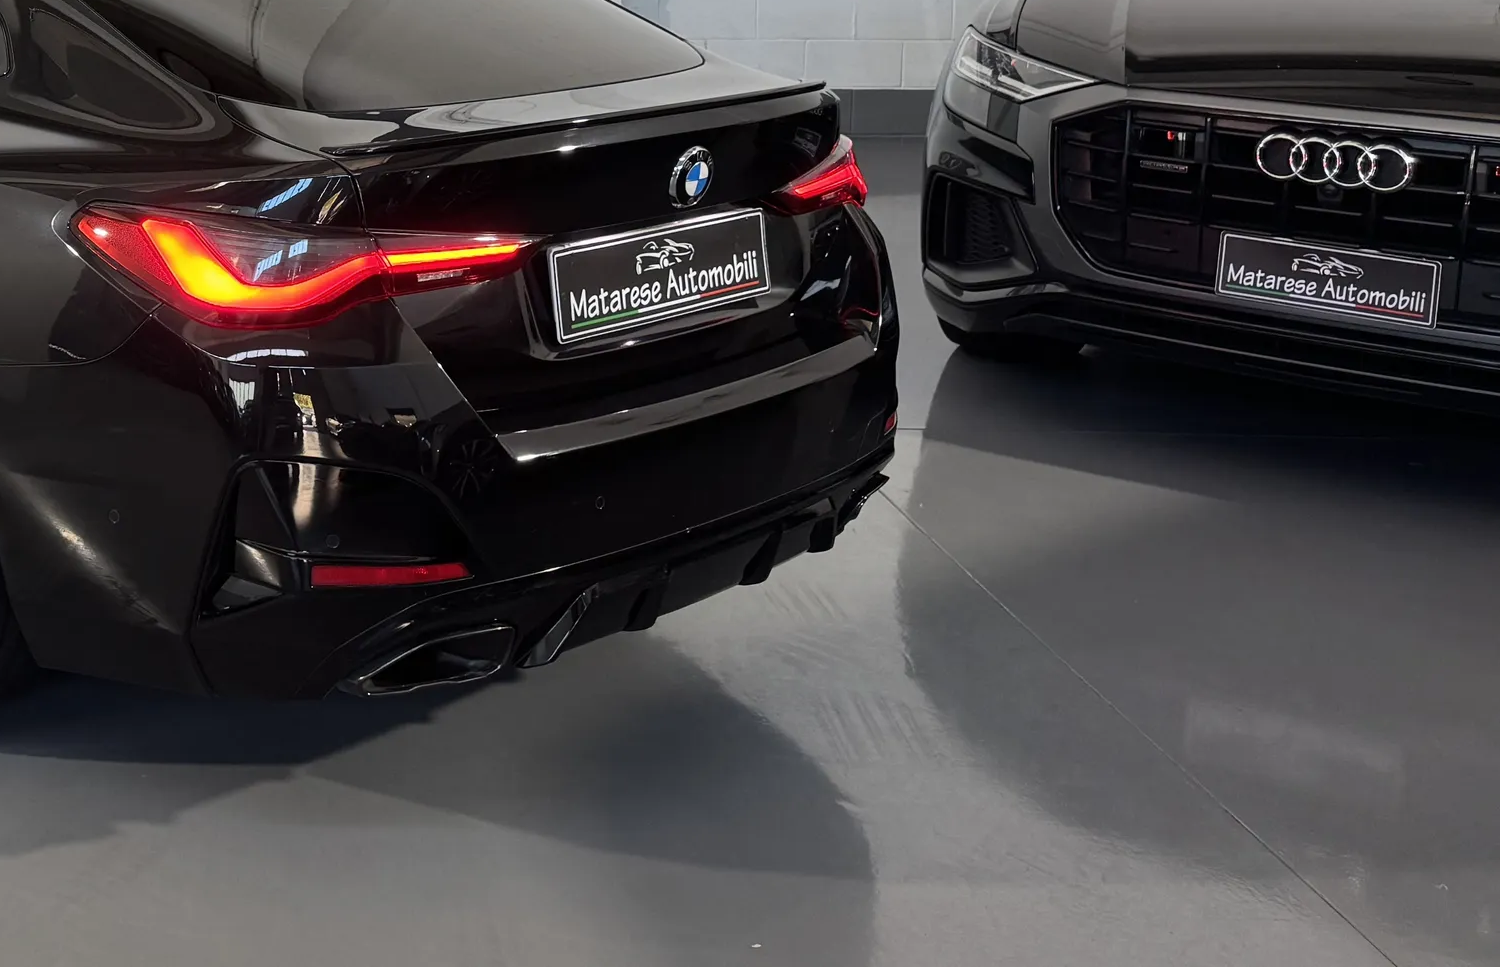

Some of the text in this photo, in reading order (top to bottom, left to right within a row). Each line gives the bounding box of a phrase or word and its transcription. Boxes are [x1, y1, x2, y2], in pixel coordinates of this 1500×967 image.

[569, 250, 758, 322] Matarese Automobili
[1226, 263, 1427, 313] Matarese Automobili
